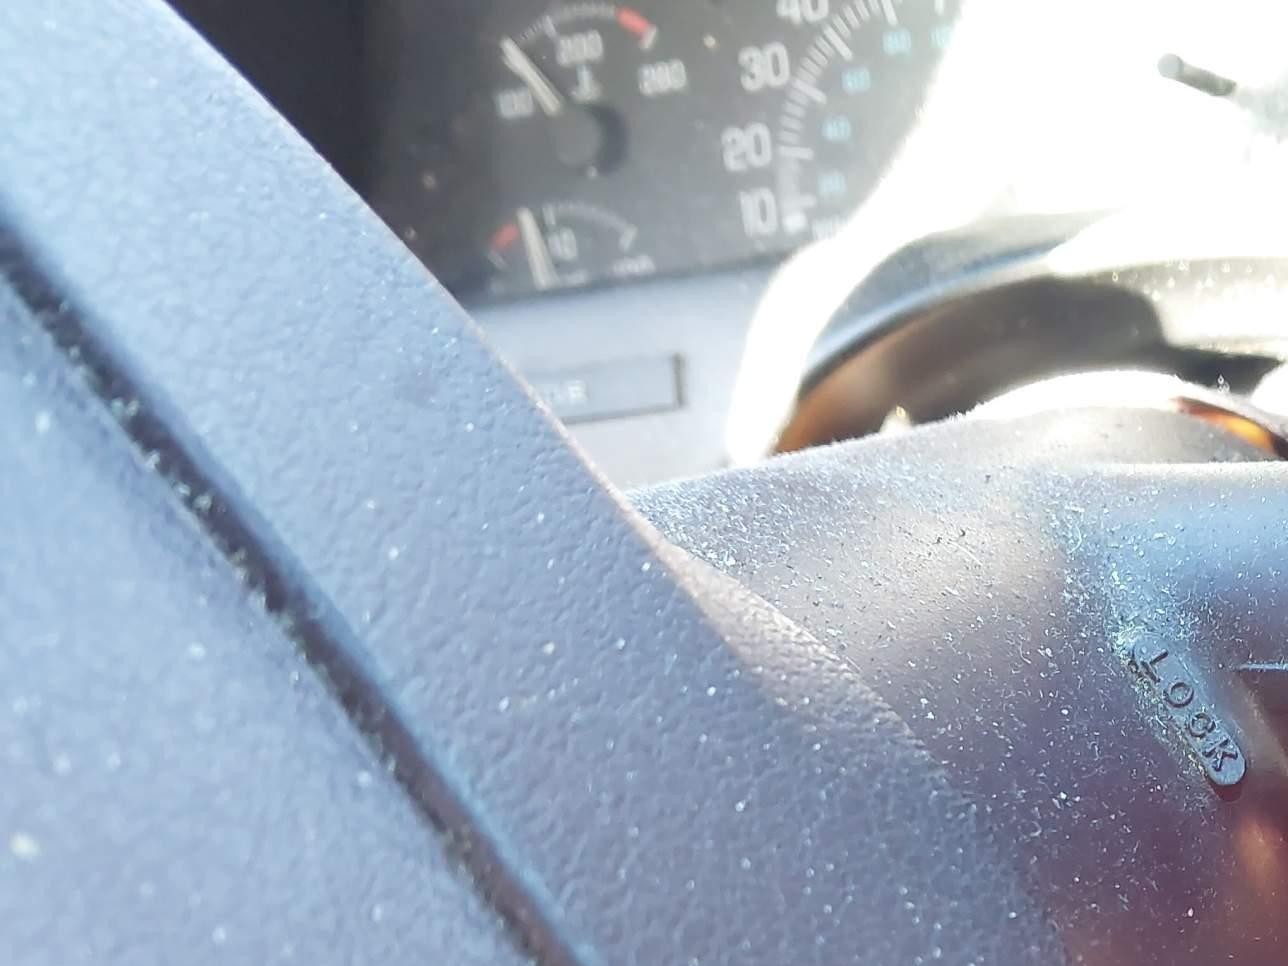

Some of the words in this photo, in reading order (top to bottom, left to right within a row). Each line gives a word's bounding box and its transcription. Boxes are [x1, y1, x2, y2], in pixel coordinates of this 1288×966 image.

[737, 41, 790, 91] 30
[720, 122, 772, 172] 20
[738, 186, 778, 238] 10
[1137, 650, 1239, 772] LOCK
